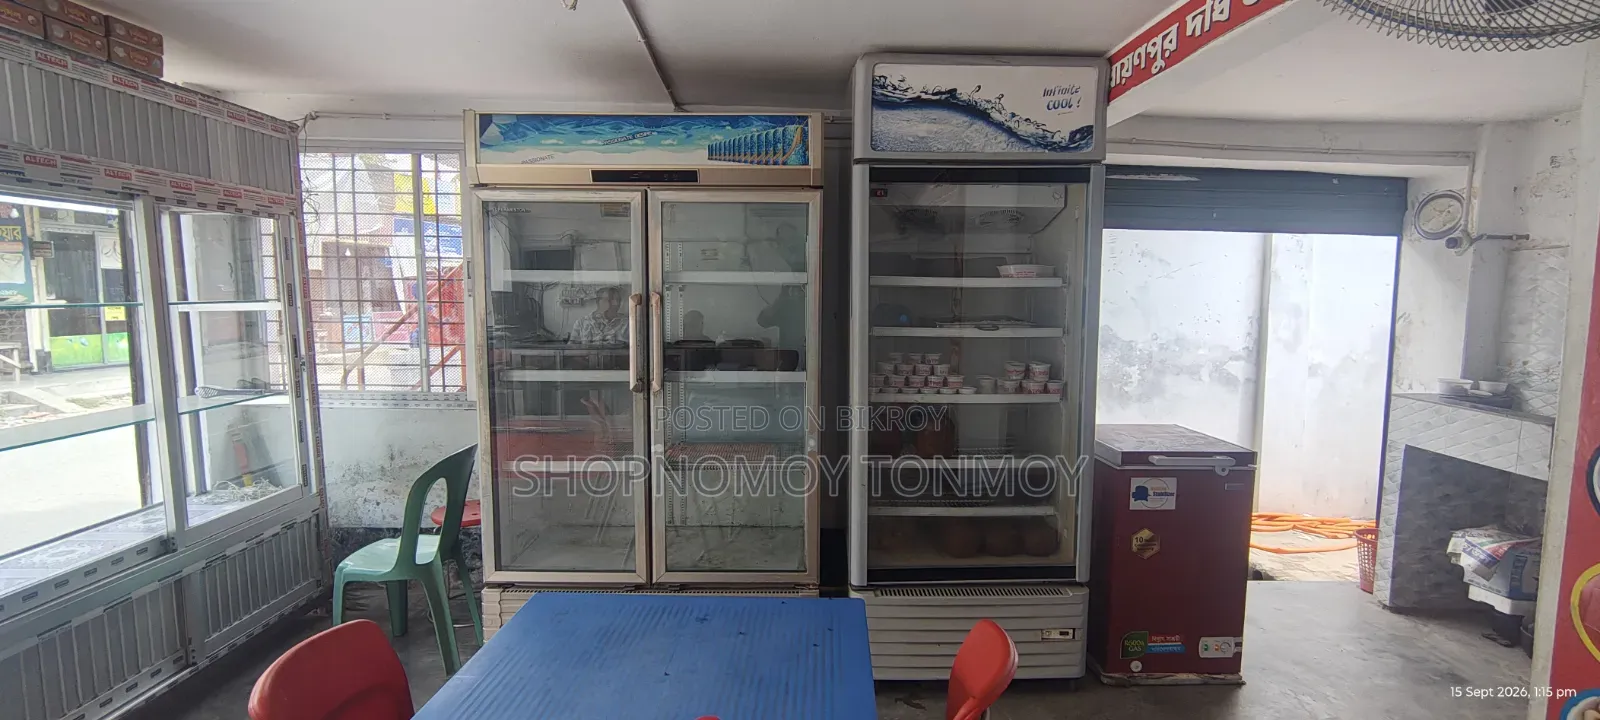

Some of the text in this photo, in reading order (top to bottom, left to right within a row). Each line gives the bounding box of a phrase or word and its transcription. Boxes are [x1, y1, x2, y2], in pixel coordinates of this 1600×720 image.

[1043, 84, 1081, 97] Infinite
[25, 155, 57, 167] ALTECH
[521, 153, 555, 165] PASSIONATE
[104, 169, 132, 179] ALTECH
[170, 181, 192, 190] ALTECH
